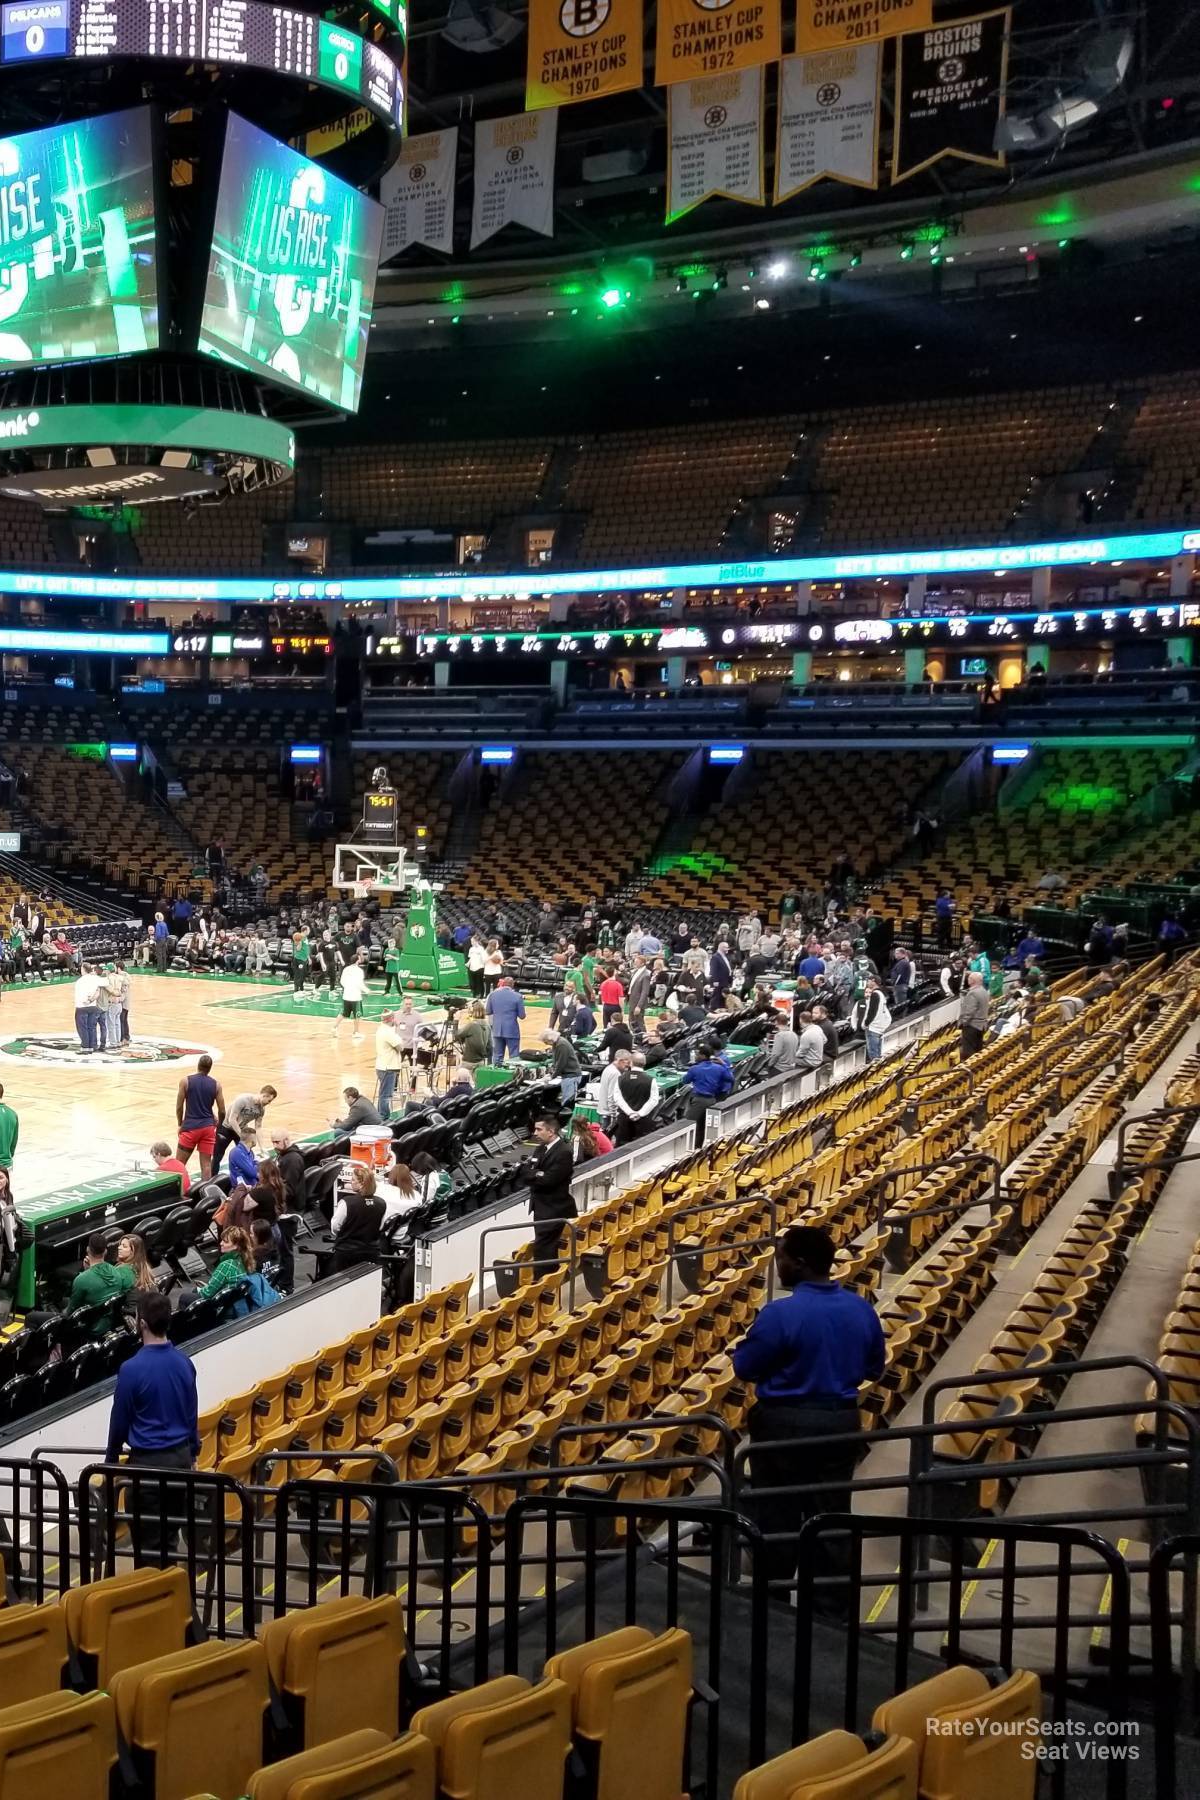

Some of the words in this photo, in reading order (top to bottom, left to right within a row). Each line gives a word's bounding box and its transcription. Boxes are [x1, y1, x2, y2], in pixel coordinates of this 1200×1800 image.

[10, 5, 62, 23] PELICANS
[674, 15, 732, 41] STANLEY
[736, 6, 763, 27] CUP
[813, 0, 913, 28] CHAMPIONS
[26, 25, 44, 52] 0
[846, 19, 880, 40] 2011
[924, 21, 983, 47] BOSTON
[543, 43, 598, 66] STANLEY
[601, 34, 627, 54] CUP
[672, 25, 764, 58] CHAMPIONS
[923, 36, 981, 62] BRUINS
[335, 53, 348, 80] 0
[541, 53, 627, 84] CHAMPIONS
[701, 51, 735, 71] 1972
[569, 77, 600, 96] 1970
[927, 90, 972, 106] TROPHY
[488, 172, 539, 187] CHAMPIONS
[494, 165, 535, 178] DIVISION
[393, 190, 442, 203] CHAMPIONS
[398, 181, 435, 194] DIVISION
[267, 204, 295, 265] US
[293, 209, 331, 268] RISE
[719, 564, 765, 581] jetBlue
[722, 628, 735, 643] 0
[809, 625, 822, 640] 0
[174, 637, 207, 652] 6:17
